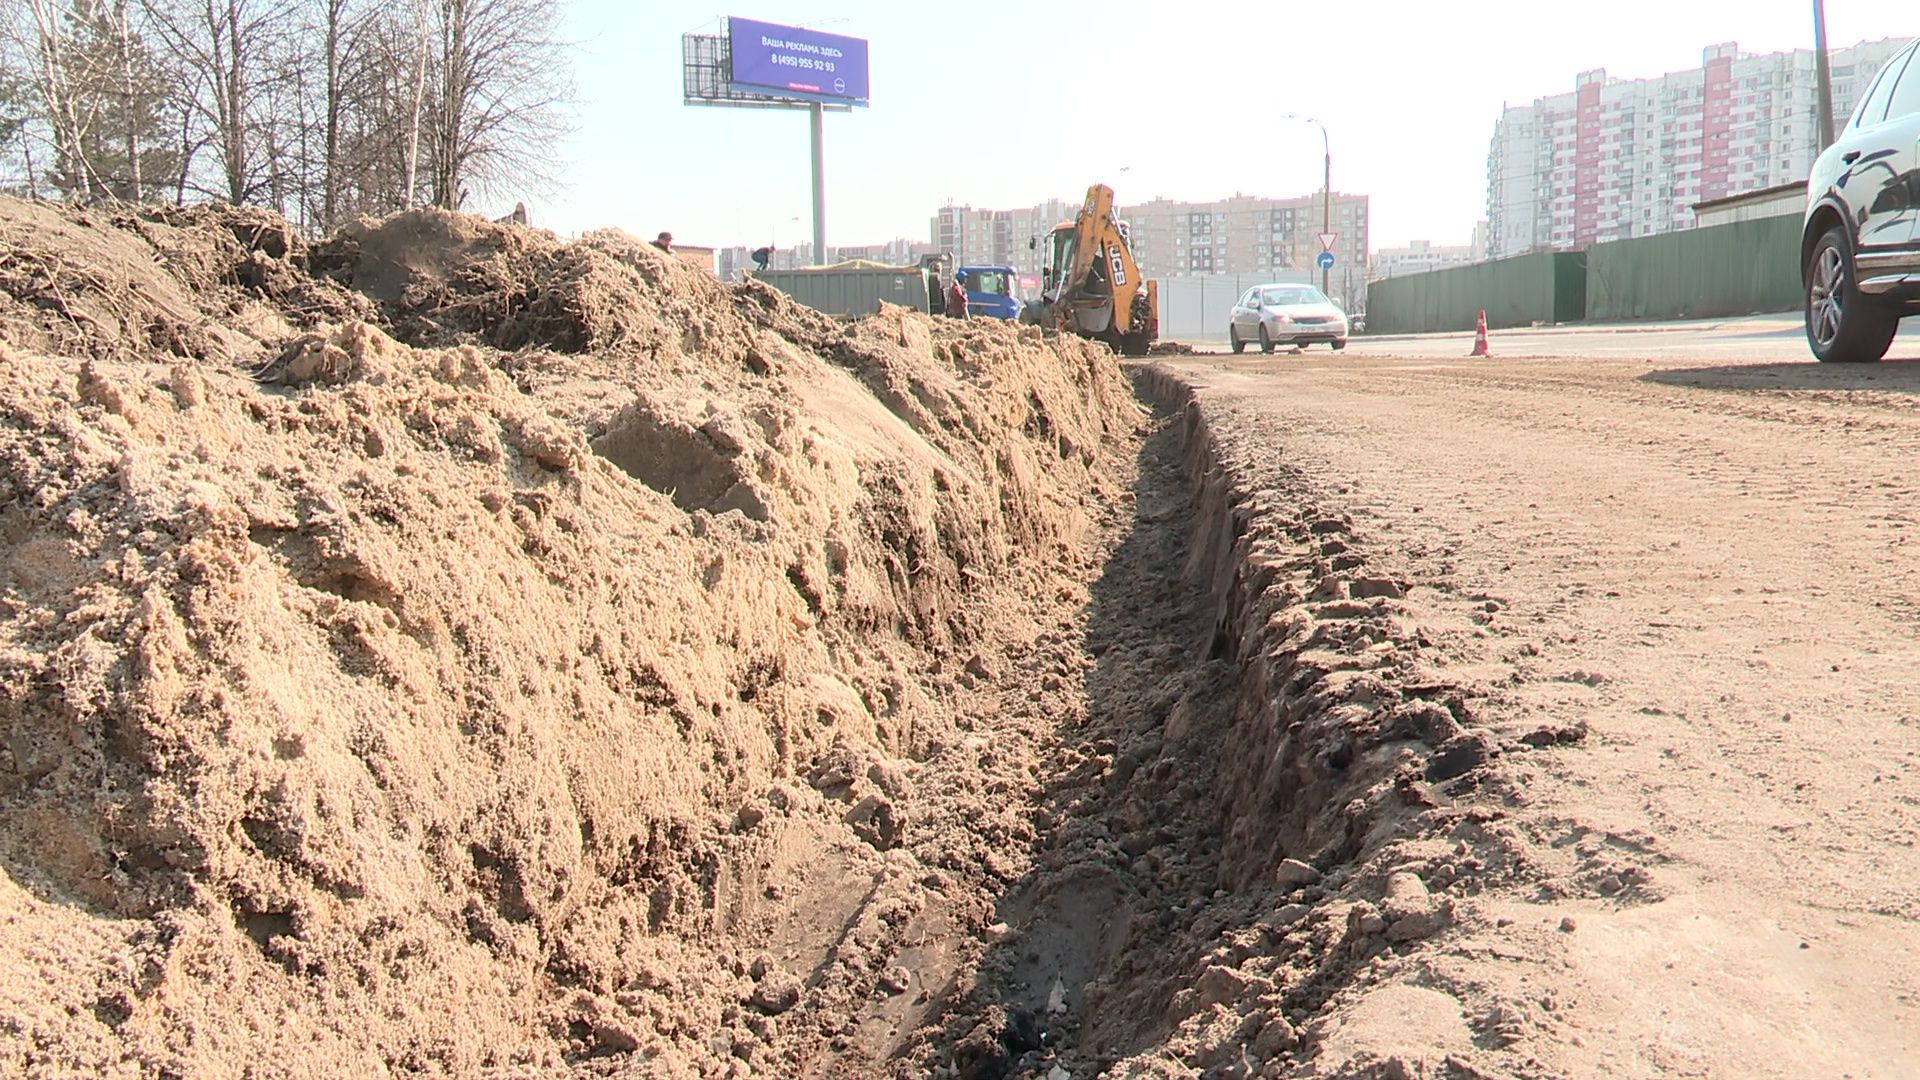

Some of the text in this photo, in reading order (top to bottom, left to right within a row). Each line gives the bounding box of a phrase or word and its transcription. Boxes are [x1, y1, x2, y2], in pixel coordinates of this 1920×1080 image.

[761, 36, 843, 58] ВАША РЕКЛАМА ЗДЕСЬ
[771, 53, 835, 72] 8 (495) 955 92 93
[1110, 246, 1126, 285] JCB
